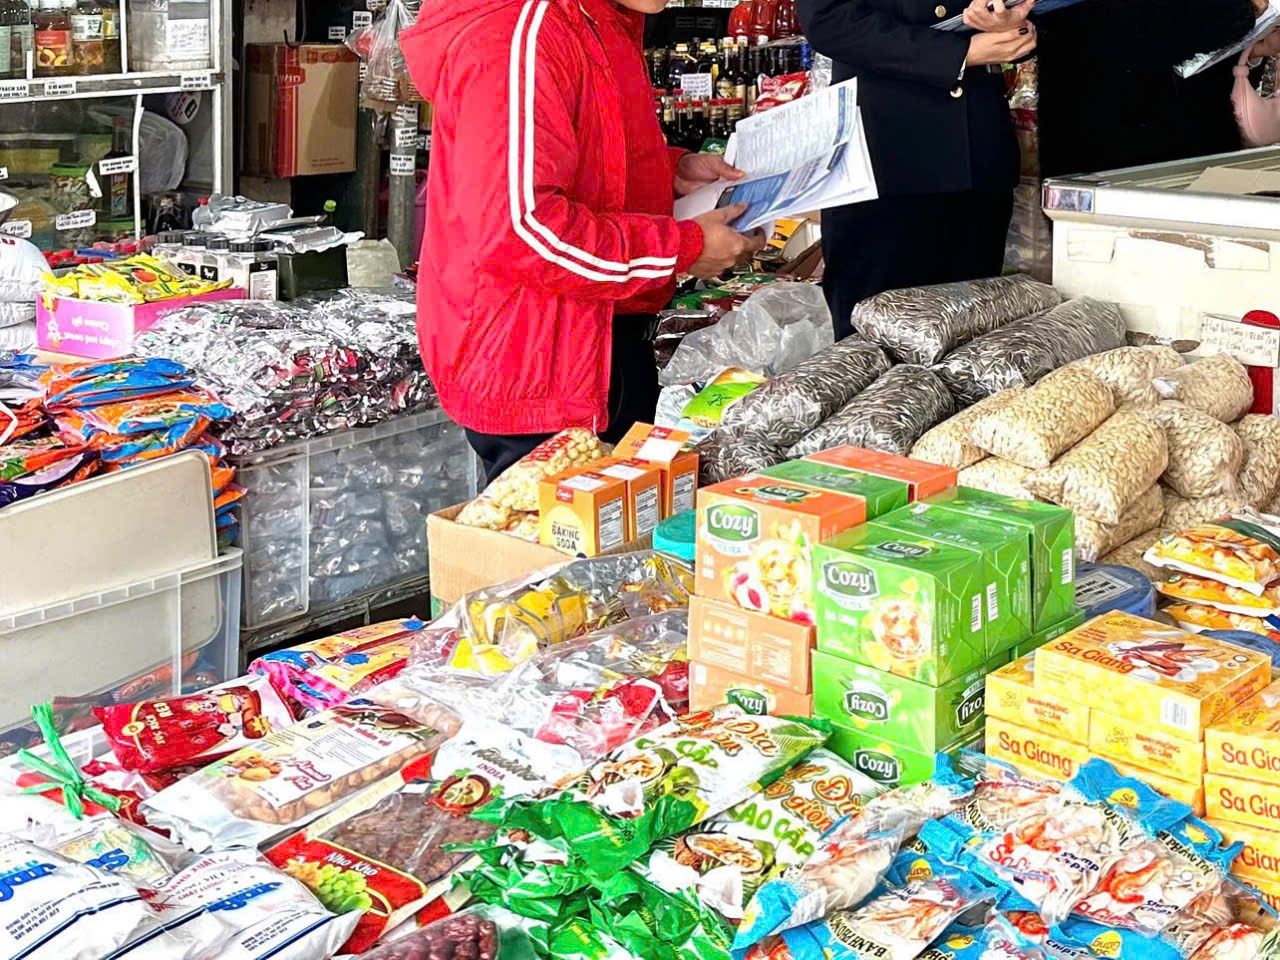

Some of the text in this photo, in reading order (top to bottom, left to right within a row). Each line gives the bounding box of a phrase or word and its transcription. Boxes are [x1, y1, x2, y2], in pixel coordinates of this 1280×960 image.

[551, 525, 580, 540] BAKING
[710, 509, 758, 536] Cozy
[556, 537, 577, 551] SODA
[827, 567, 872, 592] Cozy
[1055, 641, 1138, 674] Sa Giang
[850, 695, 887, 718] Cozy
[858, 753, 895, 779] Cozy
[999, 731, 1073, 777] Sa Giang
[1221, 742, 1247, 765] Sa
[476, 761, 507, 782] INDIA
[1219, 787, 1246, 812] Sa
[727, 802, 815, 857] CAO CẤP
[324, 851, 380, 877] Nho Khô
[852, 936, 887, 957] BÁNH
[1045, 939, 1079, 957] Chips
